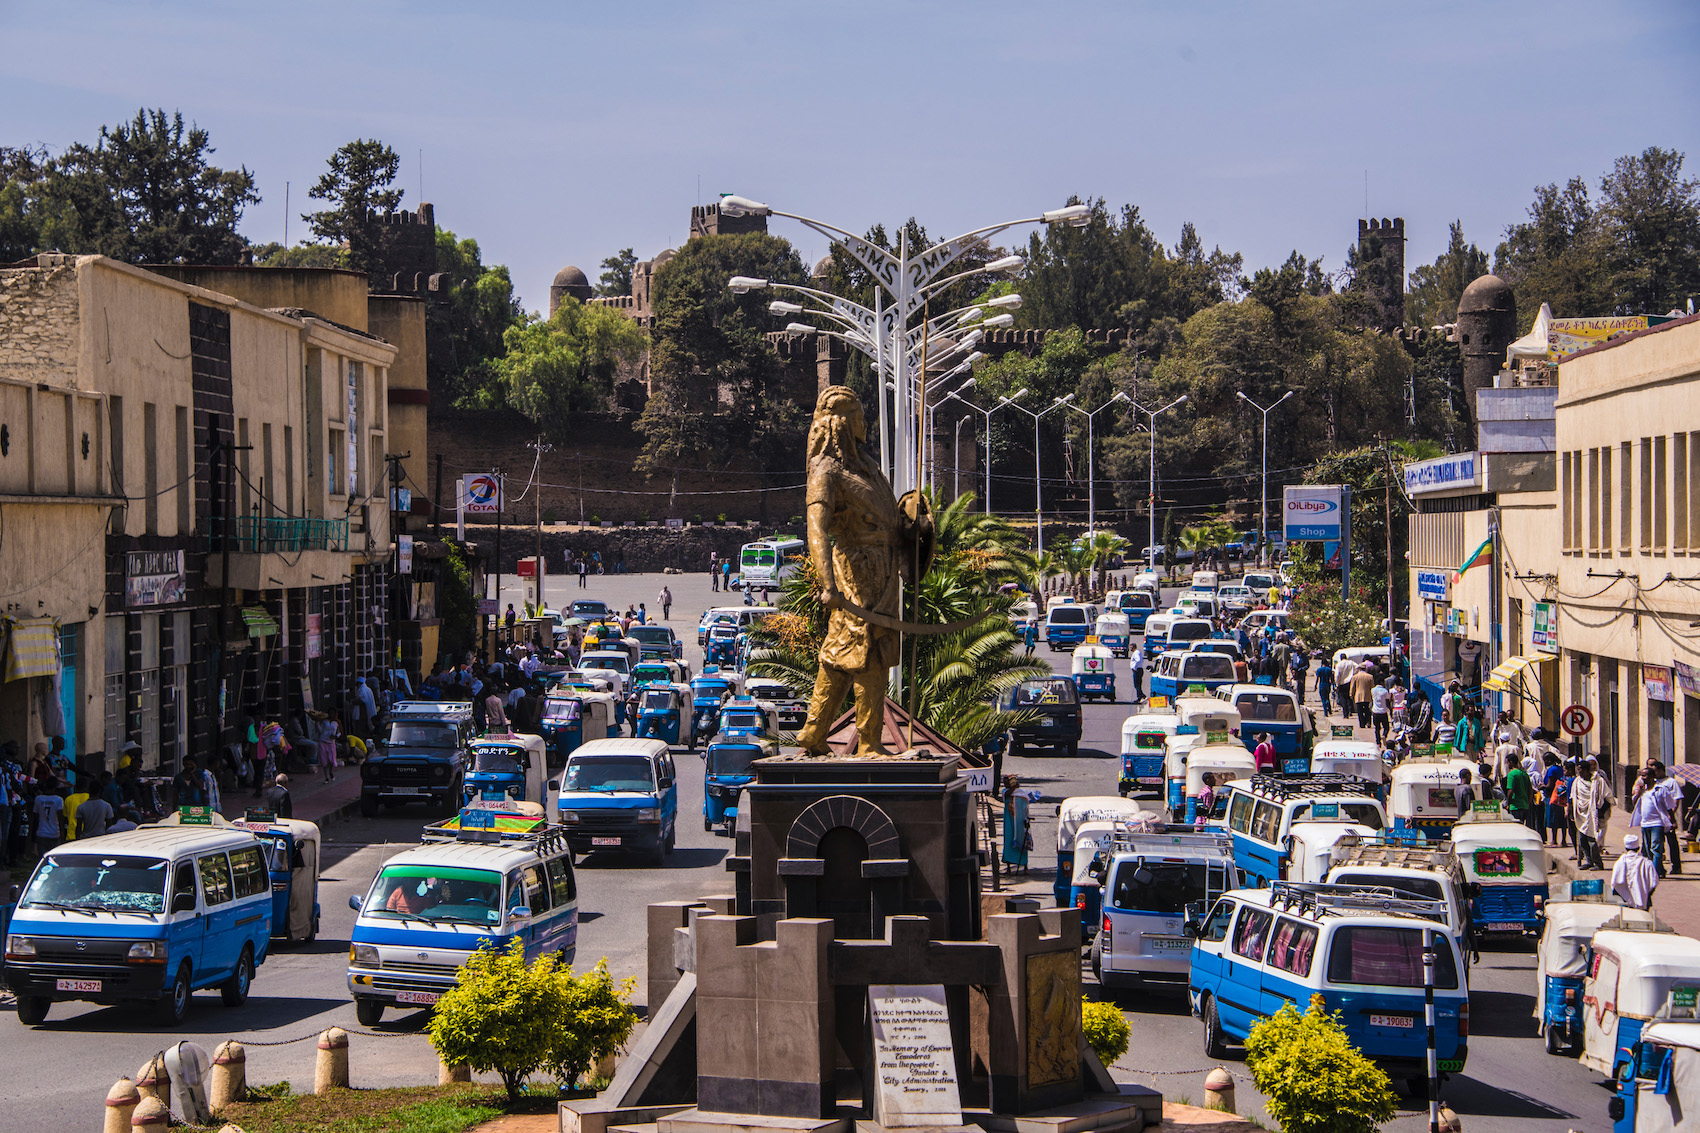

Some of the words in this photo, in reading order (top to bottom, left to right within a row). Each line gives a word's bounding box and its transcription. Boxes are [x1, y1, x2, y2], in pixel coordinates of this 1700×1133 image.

[468, 504, 502, 512] TOTAL
[1288, 502, 1326, 511] OiLibya
[1300, 528, 1326, 536] Shop
